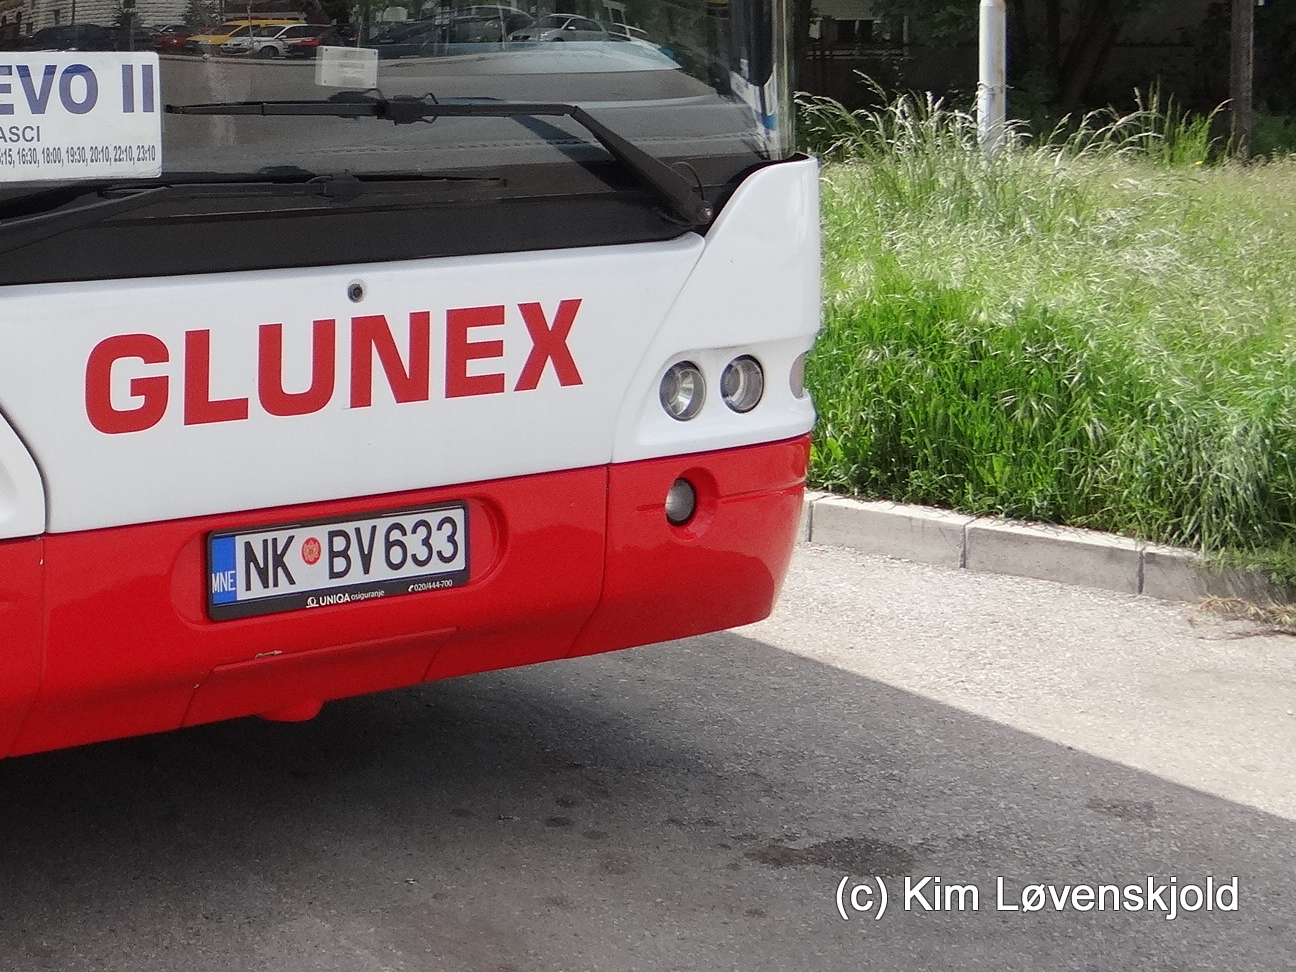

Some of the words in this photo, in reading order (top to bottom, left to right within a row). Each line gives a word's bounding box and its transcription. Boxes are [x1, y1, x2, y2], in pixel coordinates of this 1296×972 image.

[122, 64, 155, 114] II
[17, 147, 40, 168] 16:30,
[42, 147, 64, 167] 18:00,
[66, 146, 88, 167] 19:30,
[89, 145, 112, 166] 20:10,
[113, 145, 135, 165] 22:10,
[136, 144, 156, 162] 23:10
[83, 298, 584, 435] GLUNEX
[244, 535, 296, 592] NK
[327, 515, 459, 580] BV633
[212, 570, 236, 594] MNE
[319, 593, 351, 606] UNIQA
[351, 589, 385, 601] osiguranje
